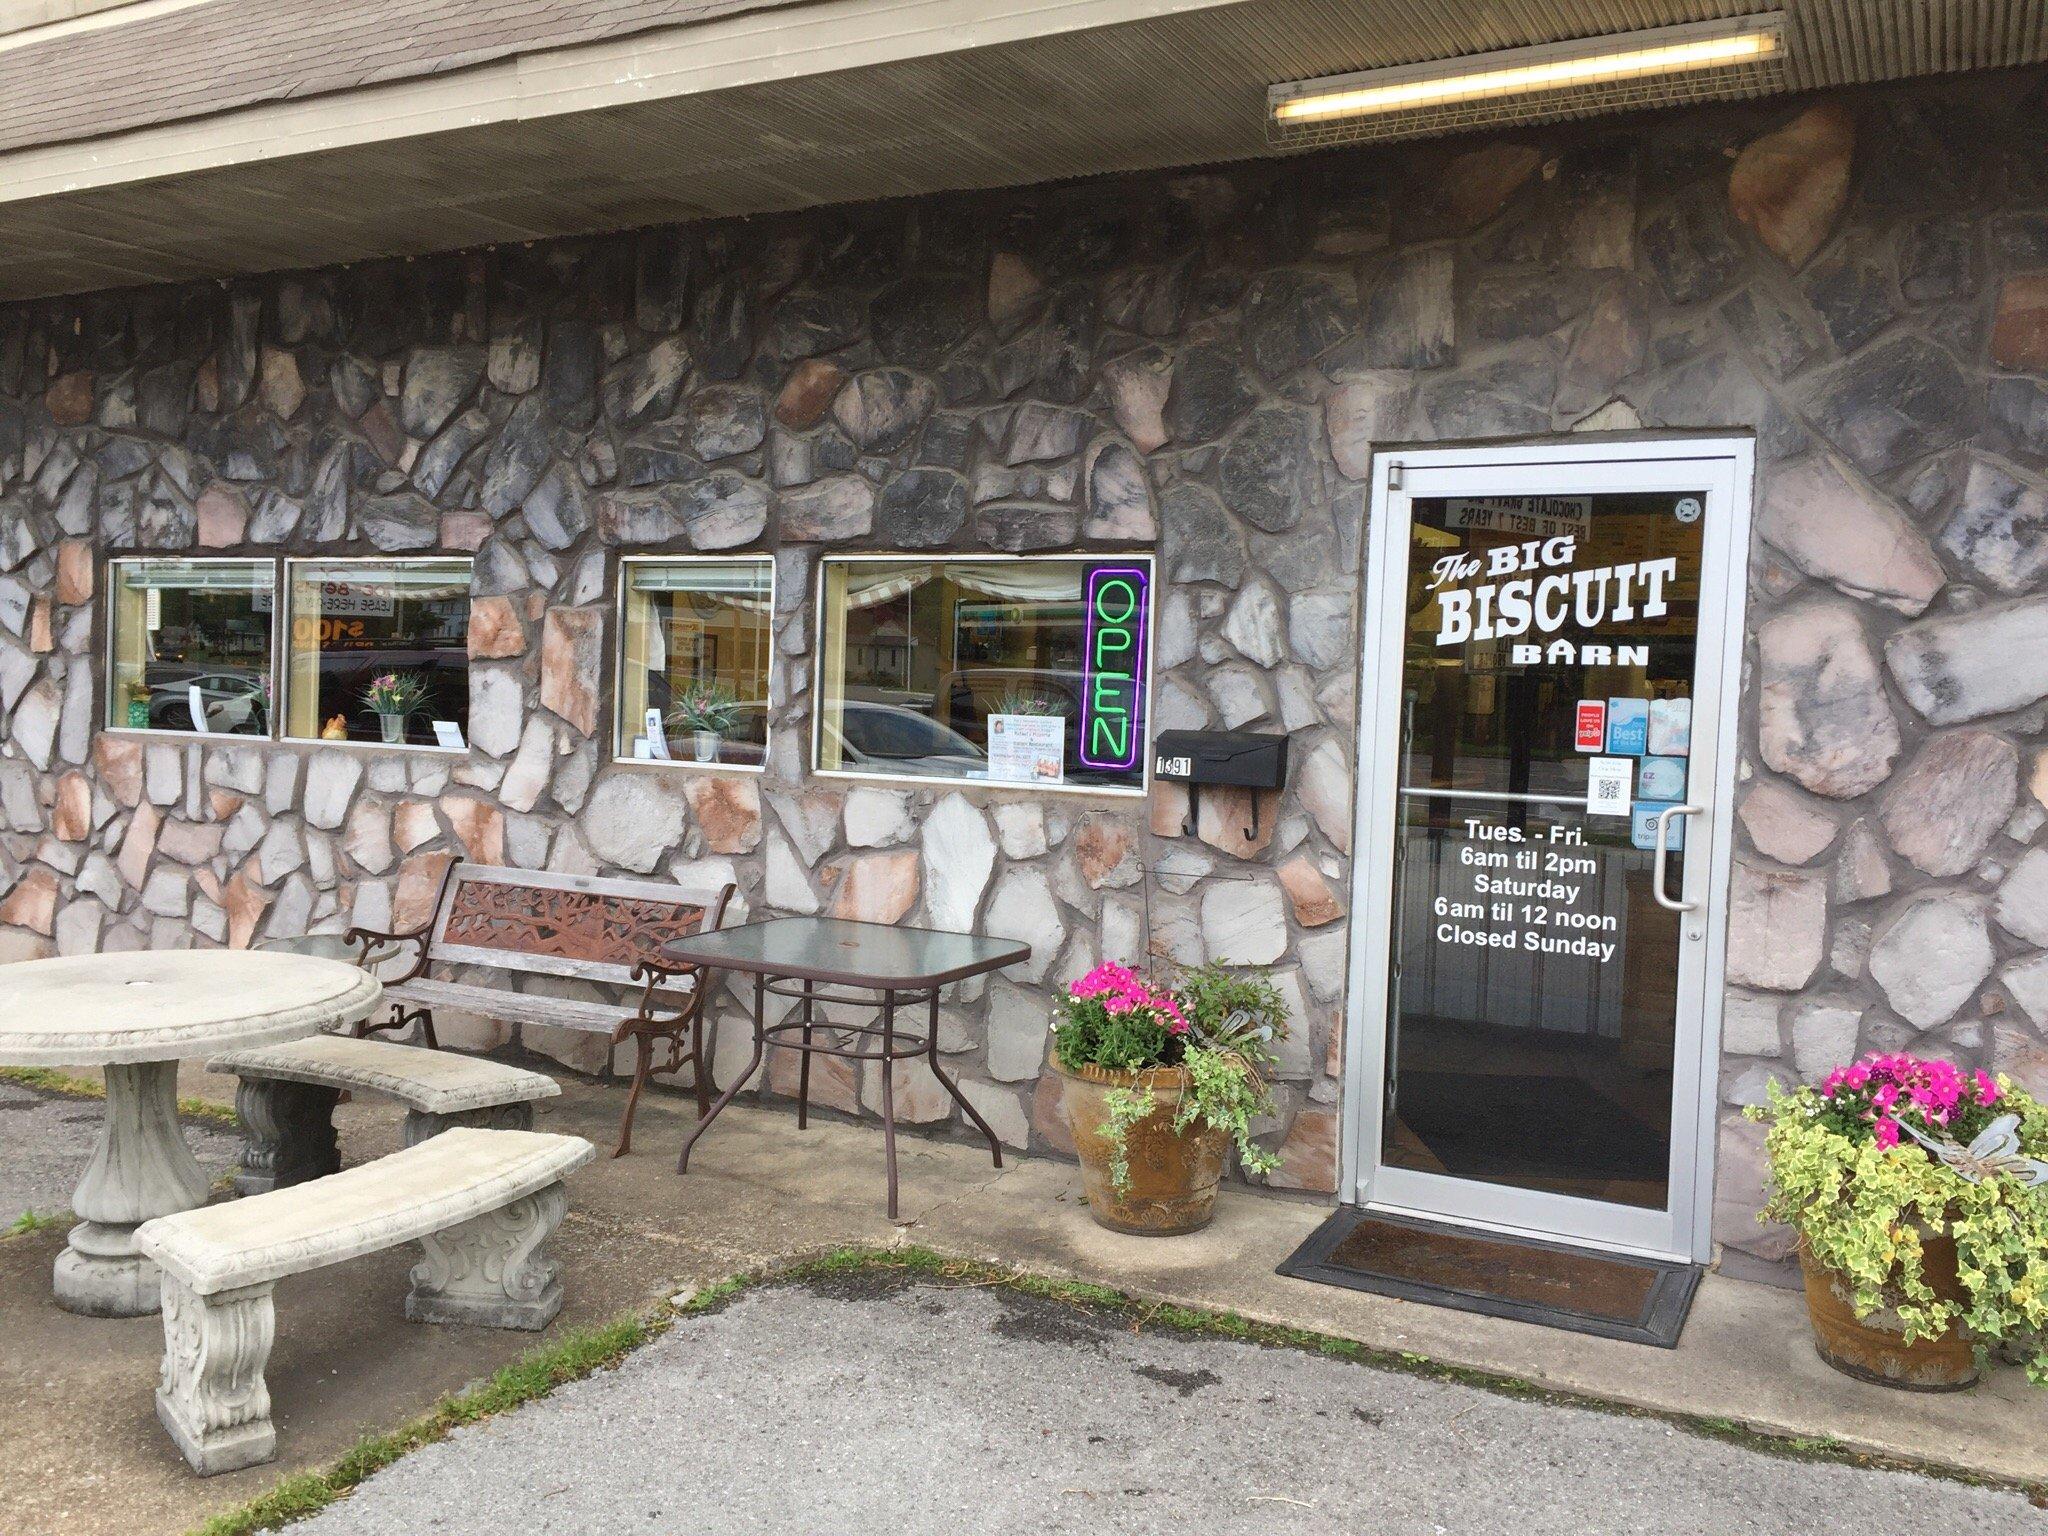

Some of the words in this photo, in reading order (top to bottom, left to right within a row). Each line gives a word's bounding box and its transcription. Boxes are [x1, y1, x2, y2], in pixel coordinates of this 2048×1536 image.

[1425, 551, 1483, 590] The
[1486, 534, 1577, 577] BIG
[1436, 557, 1677, 646] BISCUIT
[1092, 579, 1136, 757] OPEN
[1512, 638, 1649, 666] BARN
[1613, 726, 1644, 741] Best
[1464, 818, 1527, 843] Tues.
[1550, 825, 1588, 847] Fri.
[1460, 846, 1509, 868] 6am
[1515, 850, 1538, 873] til
[1544, 852, 1597, 877] 2pm
[1473, 873, 1581, 905] Saturday
[1434, 896, 1485, 920] 6am
[1490, 900, 1513, 922] til
[1521, 904, 1548, 927] 12
[1555, 911, 1617, 931] noon
[1436, 923, 1517, 949] Closed
[1523, 931, 1616, 963] Sunday
